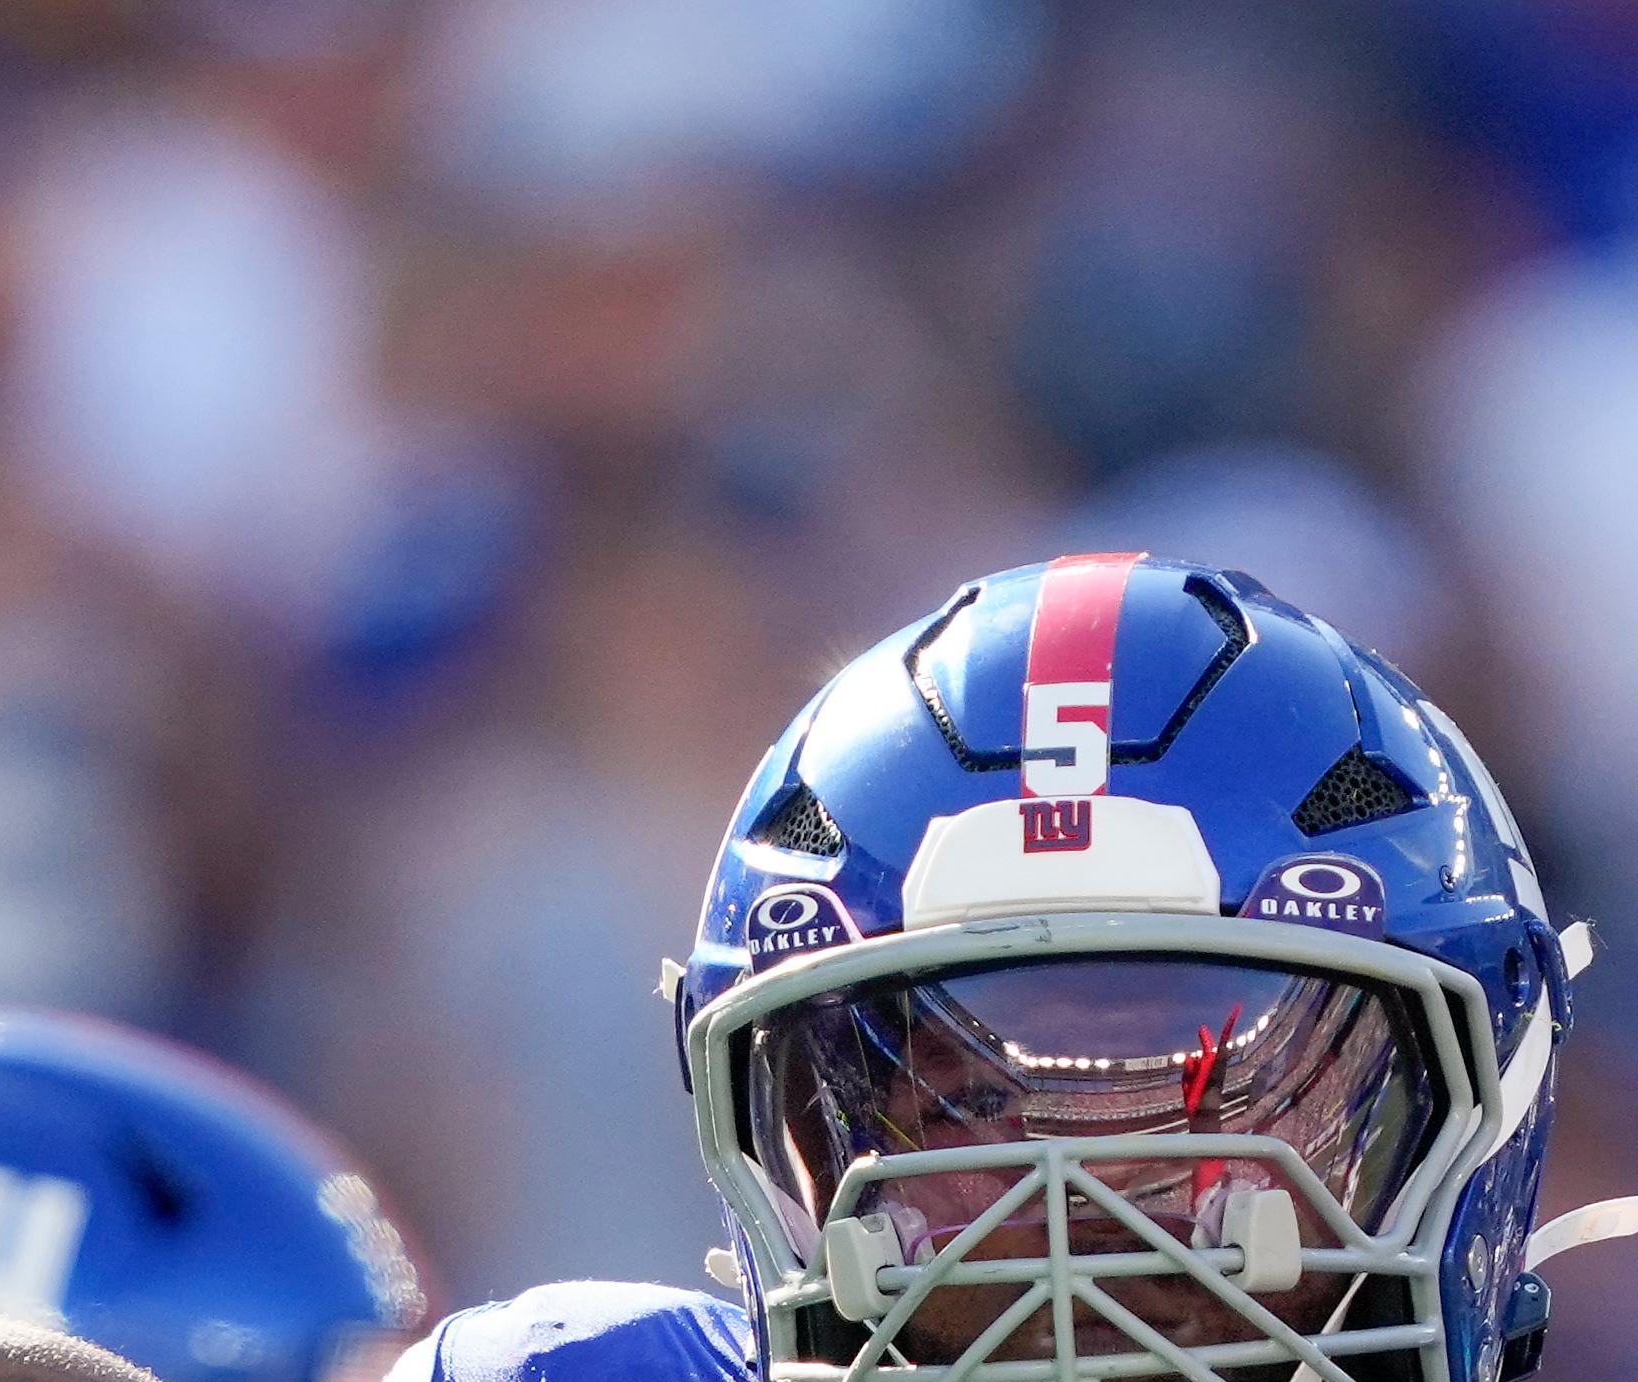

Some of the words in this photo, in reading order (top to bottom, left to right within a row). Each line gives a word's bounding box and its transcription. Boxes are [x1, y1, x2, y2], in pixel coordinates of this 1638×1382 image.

[1024, 682, 1111, 797] 5
[1019, 800, 1092, 854] ny
[1261, 898, 1377, 922] OAKLEY
[750, 924, 836, 955] OAKLEY
